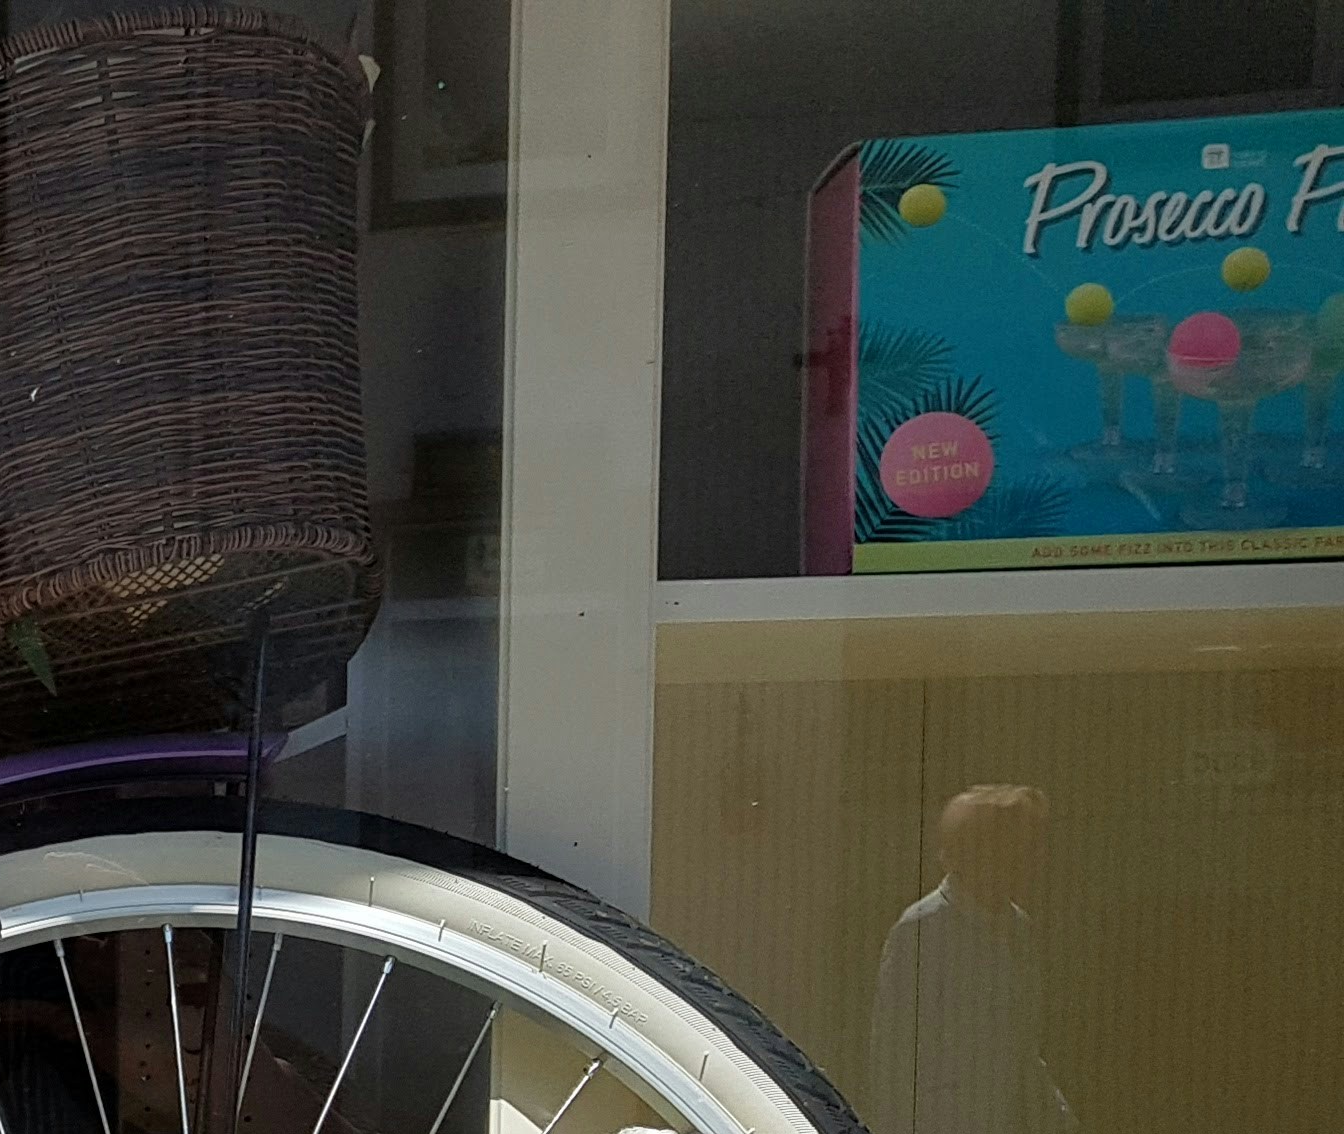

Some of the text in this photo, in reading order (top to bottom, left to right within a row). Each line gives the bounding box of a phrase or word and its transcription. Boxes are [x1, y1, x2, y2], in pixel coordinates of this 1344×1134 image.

[1022, 144, 1344, 255] Prosecco P
[911, 441, 960, 461] NEW
[894, 461, 980, 487] EDITION
[1118, 543, 1151, 556] FIZZ
[1240, 537, 1309, 551] CLASSIC
[469, 920, 523, 952] INFLATE
[573, 969, 597, 991] PSI
[618, 1002, 648, 1026] BAR
